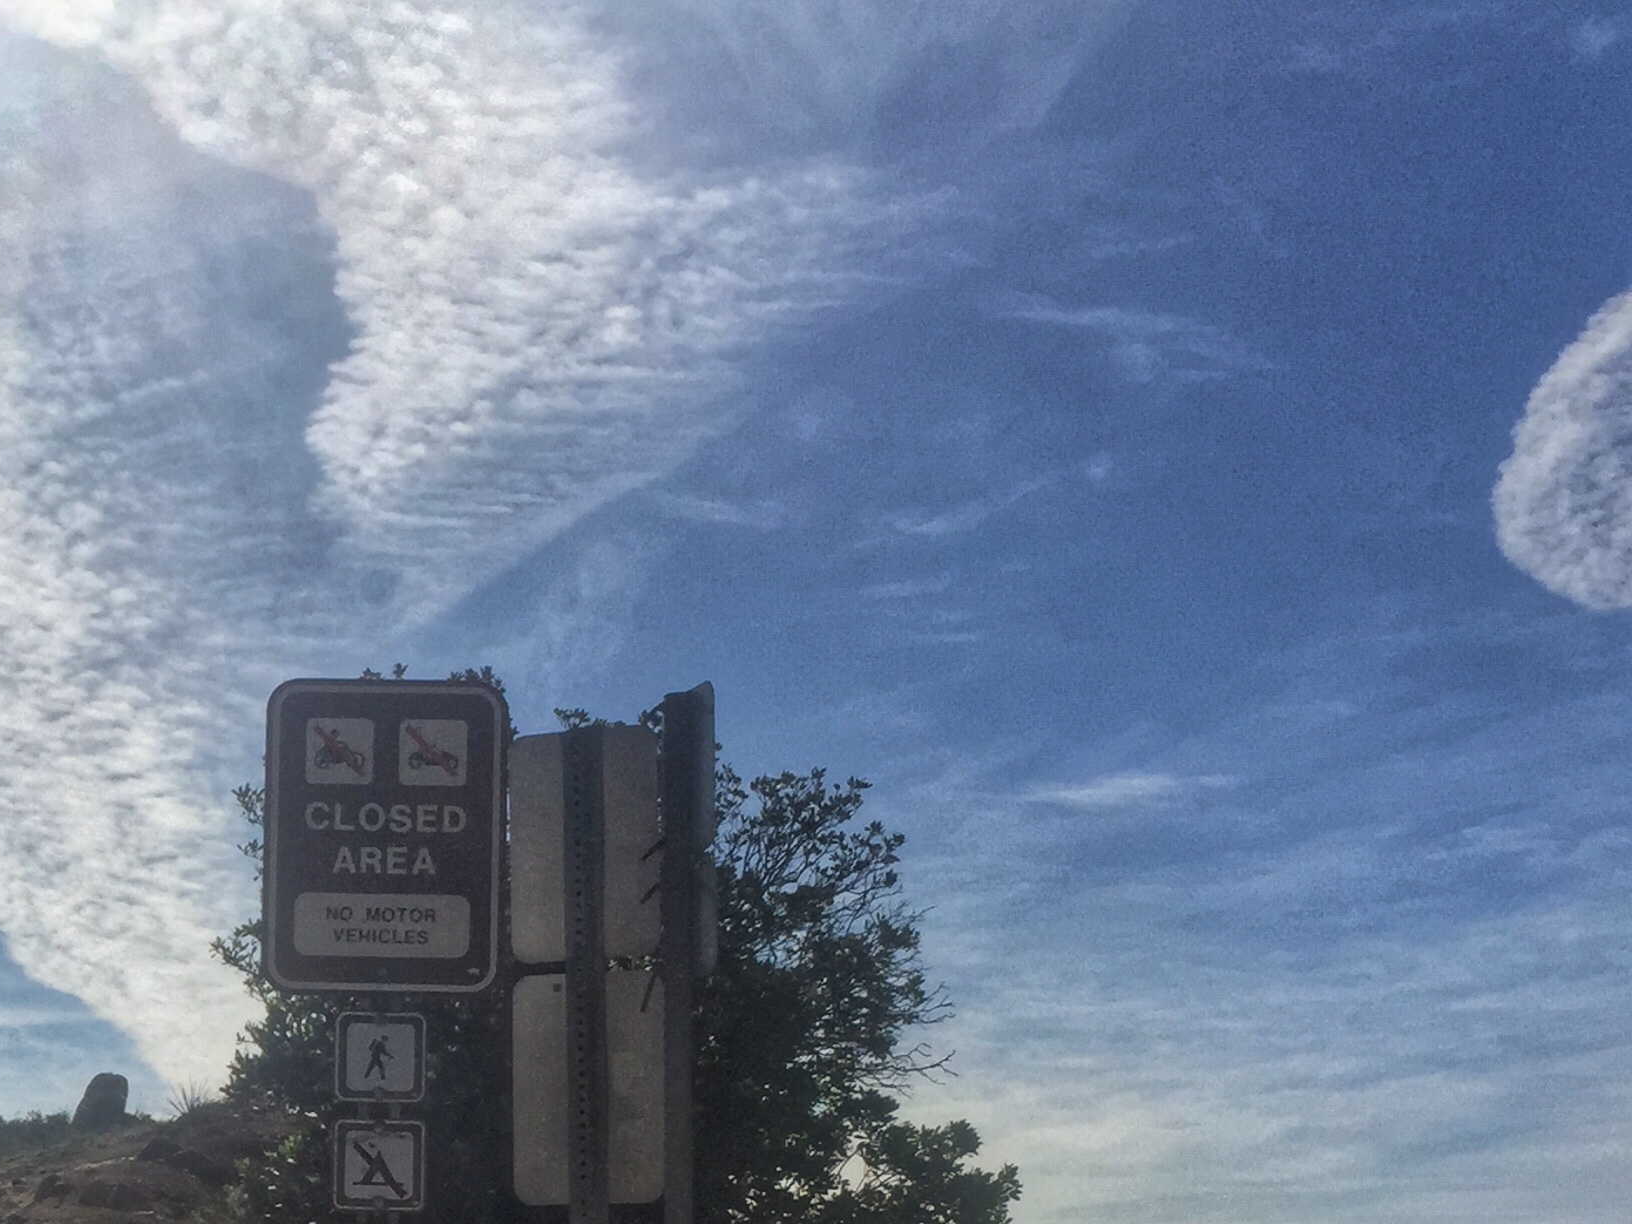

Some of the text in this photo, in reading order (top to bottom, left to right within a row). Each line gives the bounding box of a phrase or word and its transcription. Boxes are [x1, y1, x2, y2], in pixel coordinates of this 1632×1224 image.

[304, 801, 467, 833] CLOSED
[331, 846, 437, 875] AREA
[325, 906, 436, 922] NO MOTOR
[332, 927, 429, 944] VEHICLES
